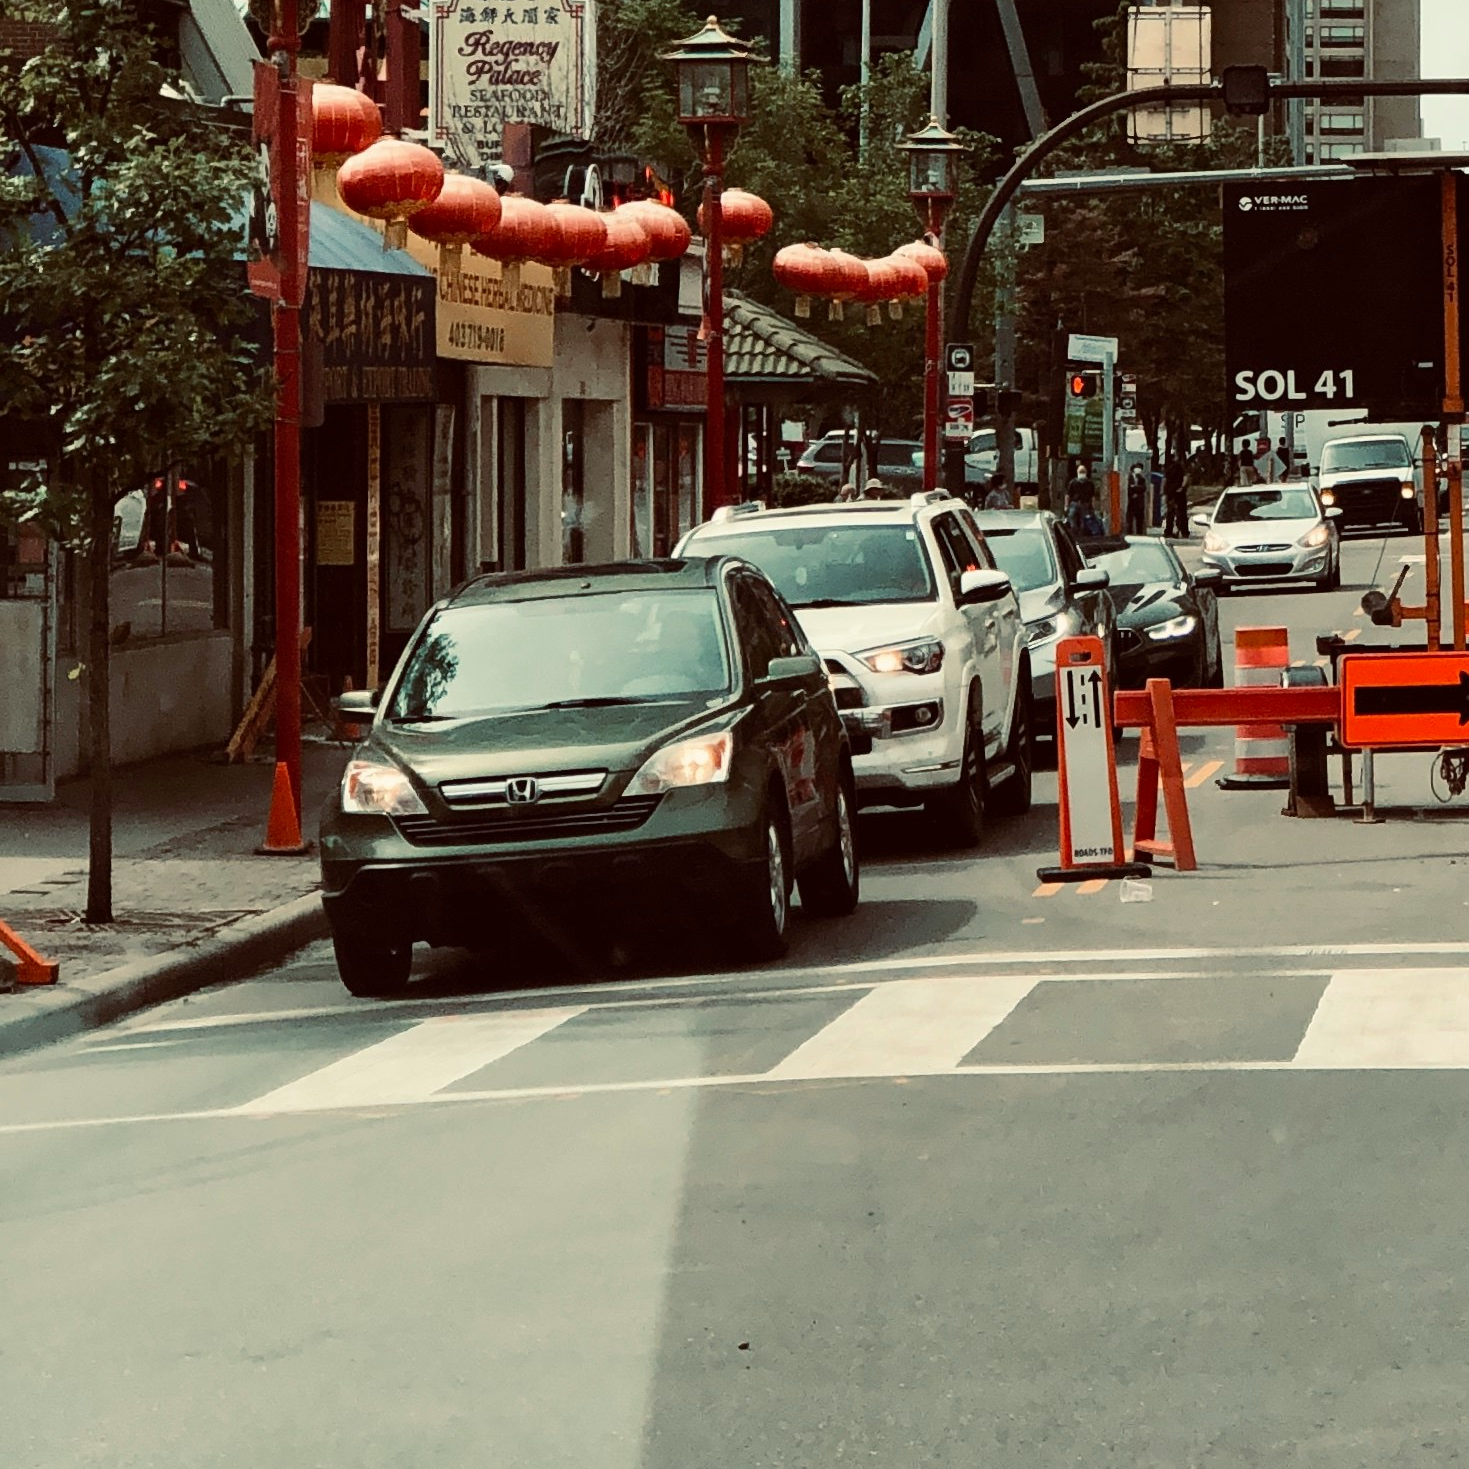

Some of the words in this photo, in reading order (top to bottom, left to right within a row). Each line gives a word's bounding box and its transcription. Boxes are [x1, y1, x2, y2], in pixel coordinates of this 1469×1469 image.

[458, 29, 560, 66] Regency
[466, 58, 543, 86] Palace
[469, 89, 551, 102] SEAFOOD
[452, 104, 564, 119] RESTAURANT
[1254, 195, 1308, 205] VER-MAC
[440, 271, 480, 305] CHINESE
[1235, 369, 1307, 401] SOL
[1313, 369, 1354, 399] 41
